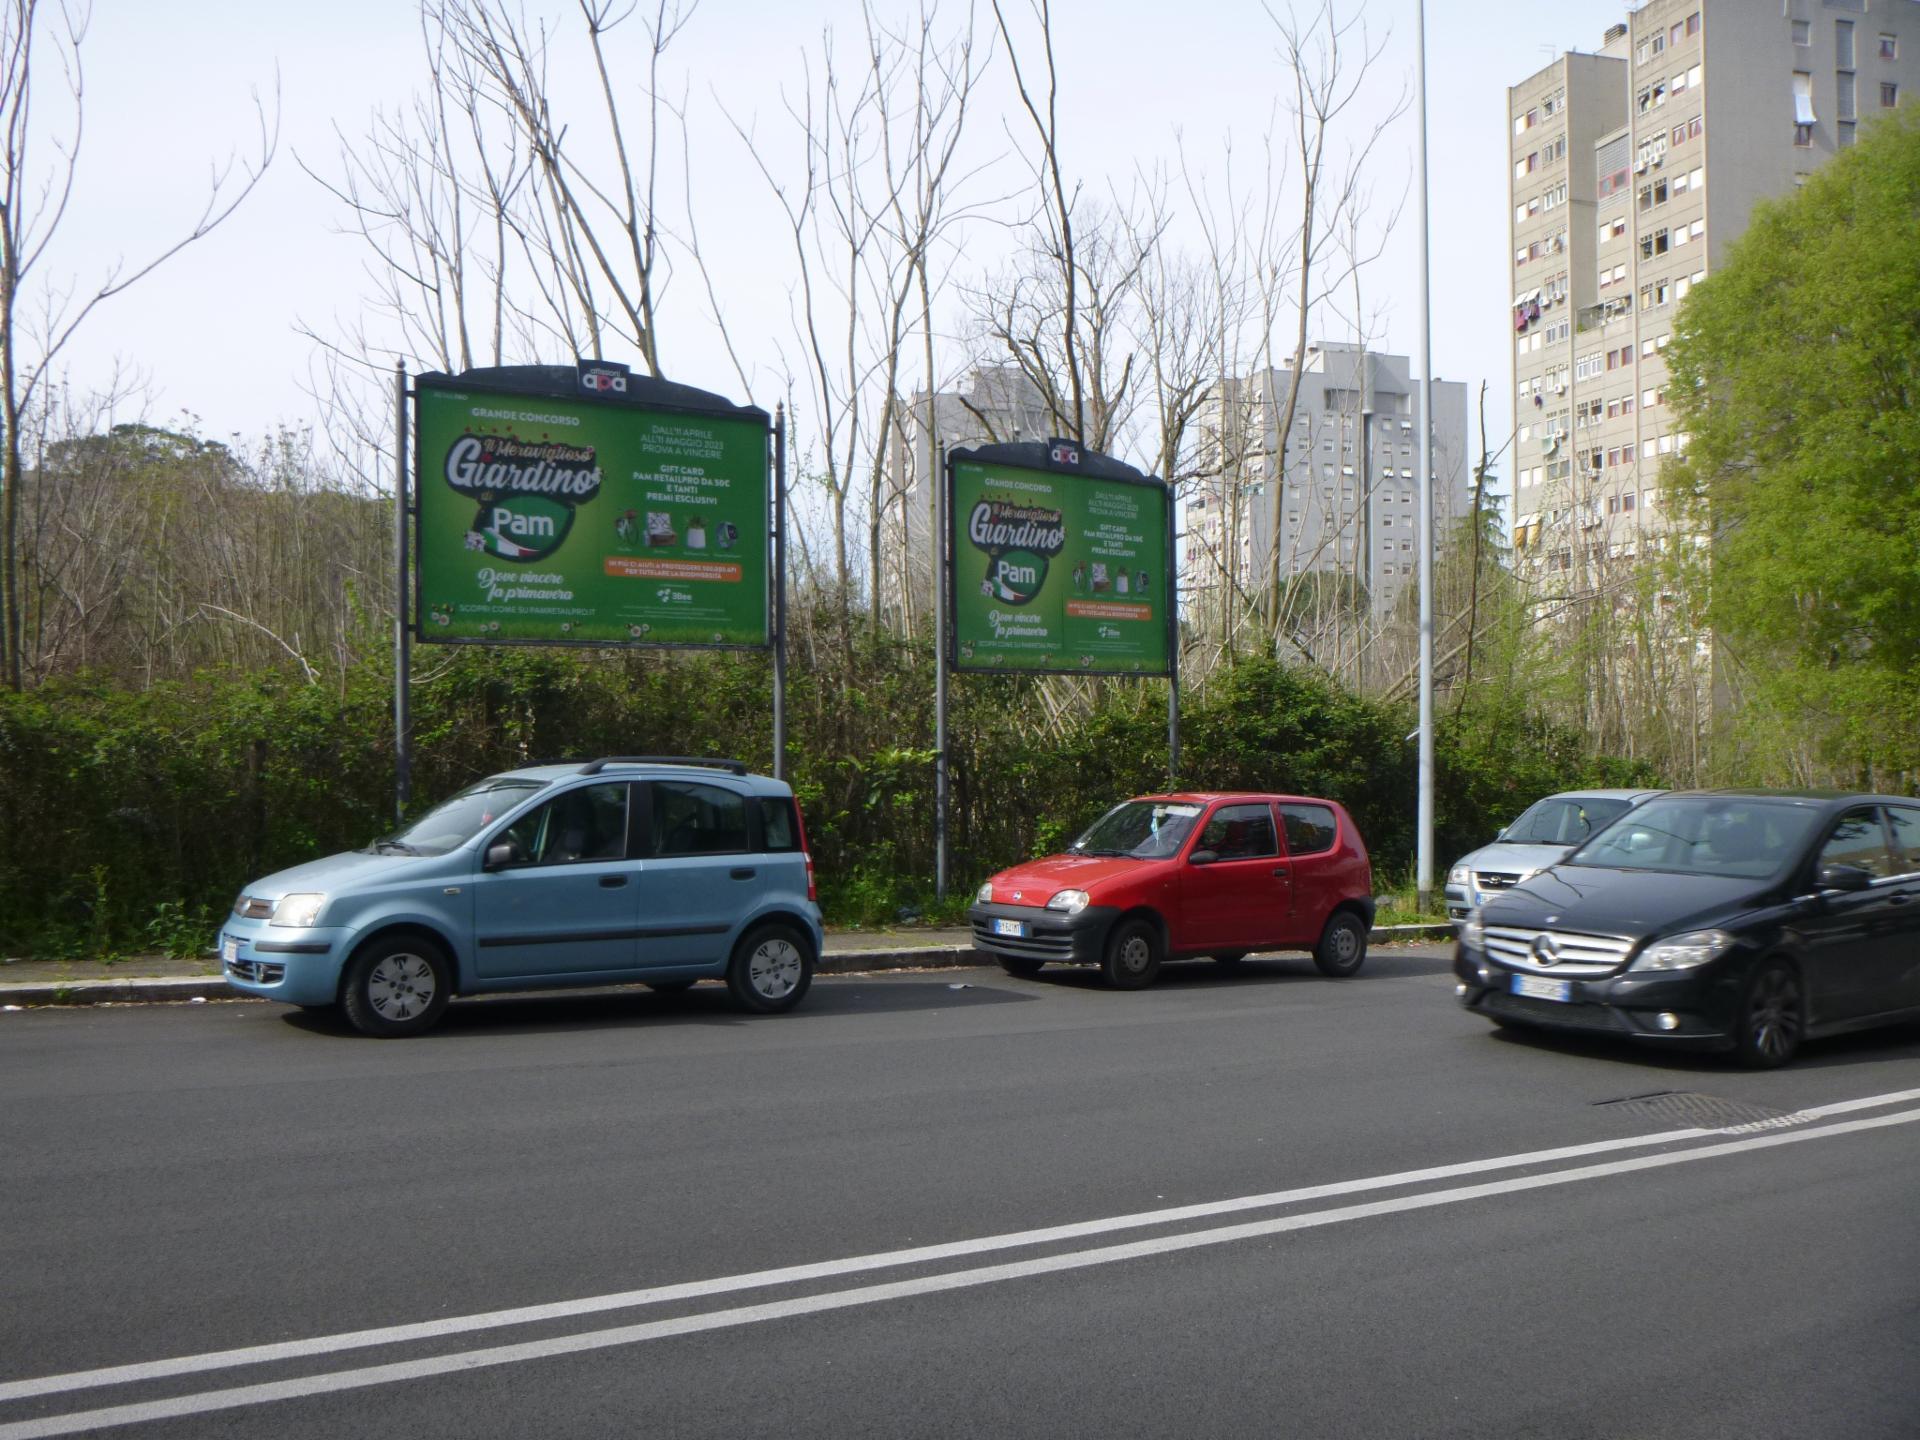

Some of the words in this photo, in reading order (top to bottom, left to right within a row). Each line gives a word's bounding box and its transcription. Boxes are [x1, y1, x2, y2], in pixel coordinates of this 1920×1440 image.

[583, 374, 627, 392] apa
[471, 407, 518, 421] GRANDE
[519, 411, 580, 426] CONCORSO
[665, 436, 703, 448] MAGGIO
[704, 440, 724, 450] 2023
[682, 428, 713, 440] APRILE
[496, 441, 593, 464] Meraviglioso
[642, 443, 673, 455] PROVA
[673, 447, 683, 455] A
[683, 447, 722, 459] VINCERE
[447, 437, 600, 495] Giardino
[660, 464, 681, 474] GIFT
[680, 466, 705, 476] CARD
[632, 471, 653, 481] PAM
[653, 473, 700, 485] RETAILPRO
[700, 478, 714, 486] DA
[984, 478, 1013, 489] GRANDE
[1014, 481, 1052, 493] CONCORSO
[646, 492, 673, 502] PREMI
[675, 494, 718, 505] ESCLUSIVI
[666, 484, 673, 493] E
[673, 485, 698, 495] TANTI
[492, 507, 554, 537] Pam
[999, 505, 1060, 523] Meraviglioso
[970, 503, 1065, 548] Giardino
[477, 567, 518, 588] Dove
[519, 571, 564, 585] vincere
[998, 560, 1036, 584] Pam
[487, 583, 504, 602] la
[504, 586, 574, 602] primavera
[491, 604, 516, 614] COME
